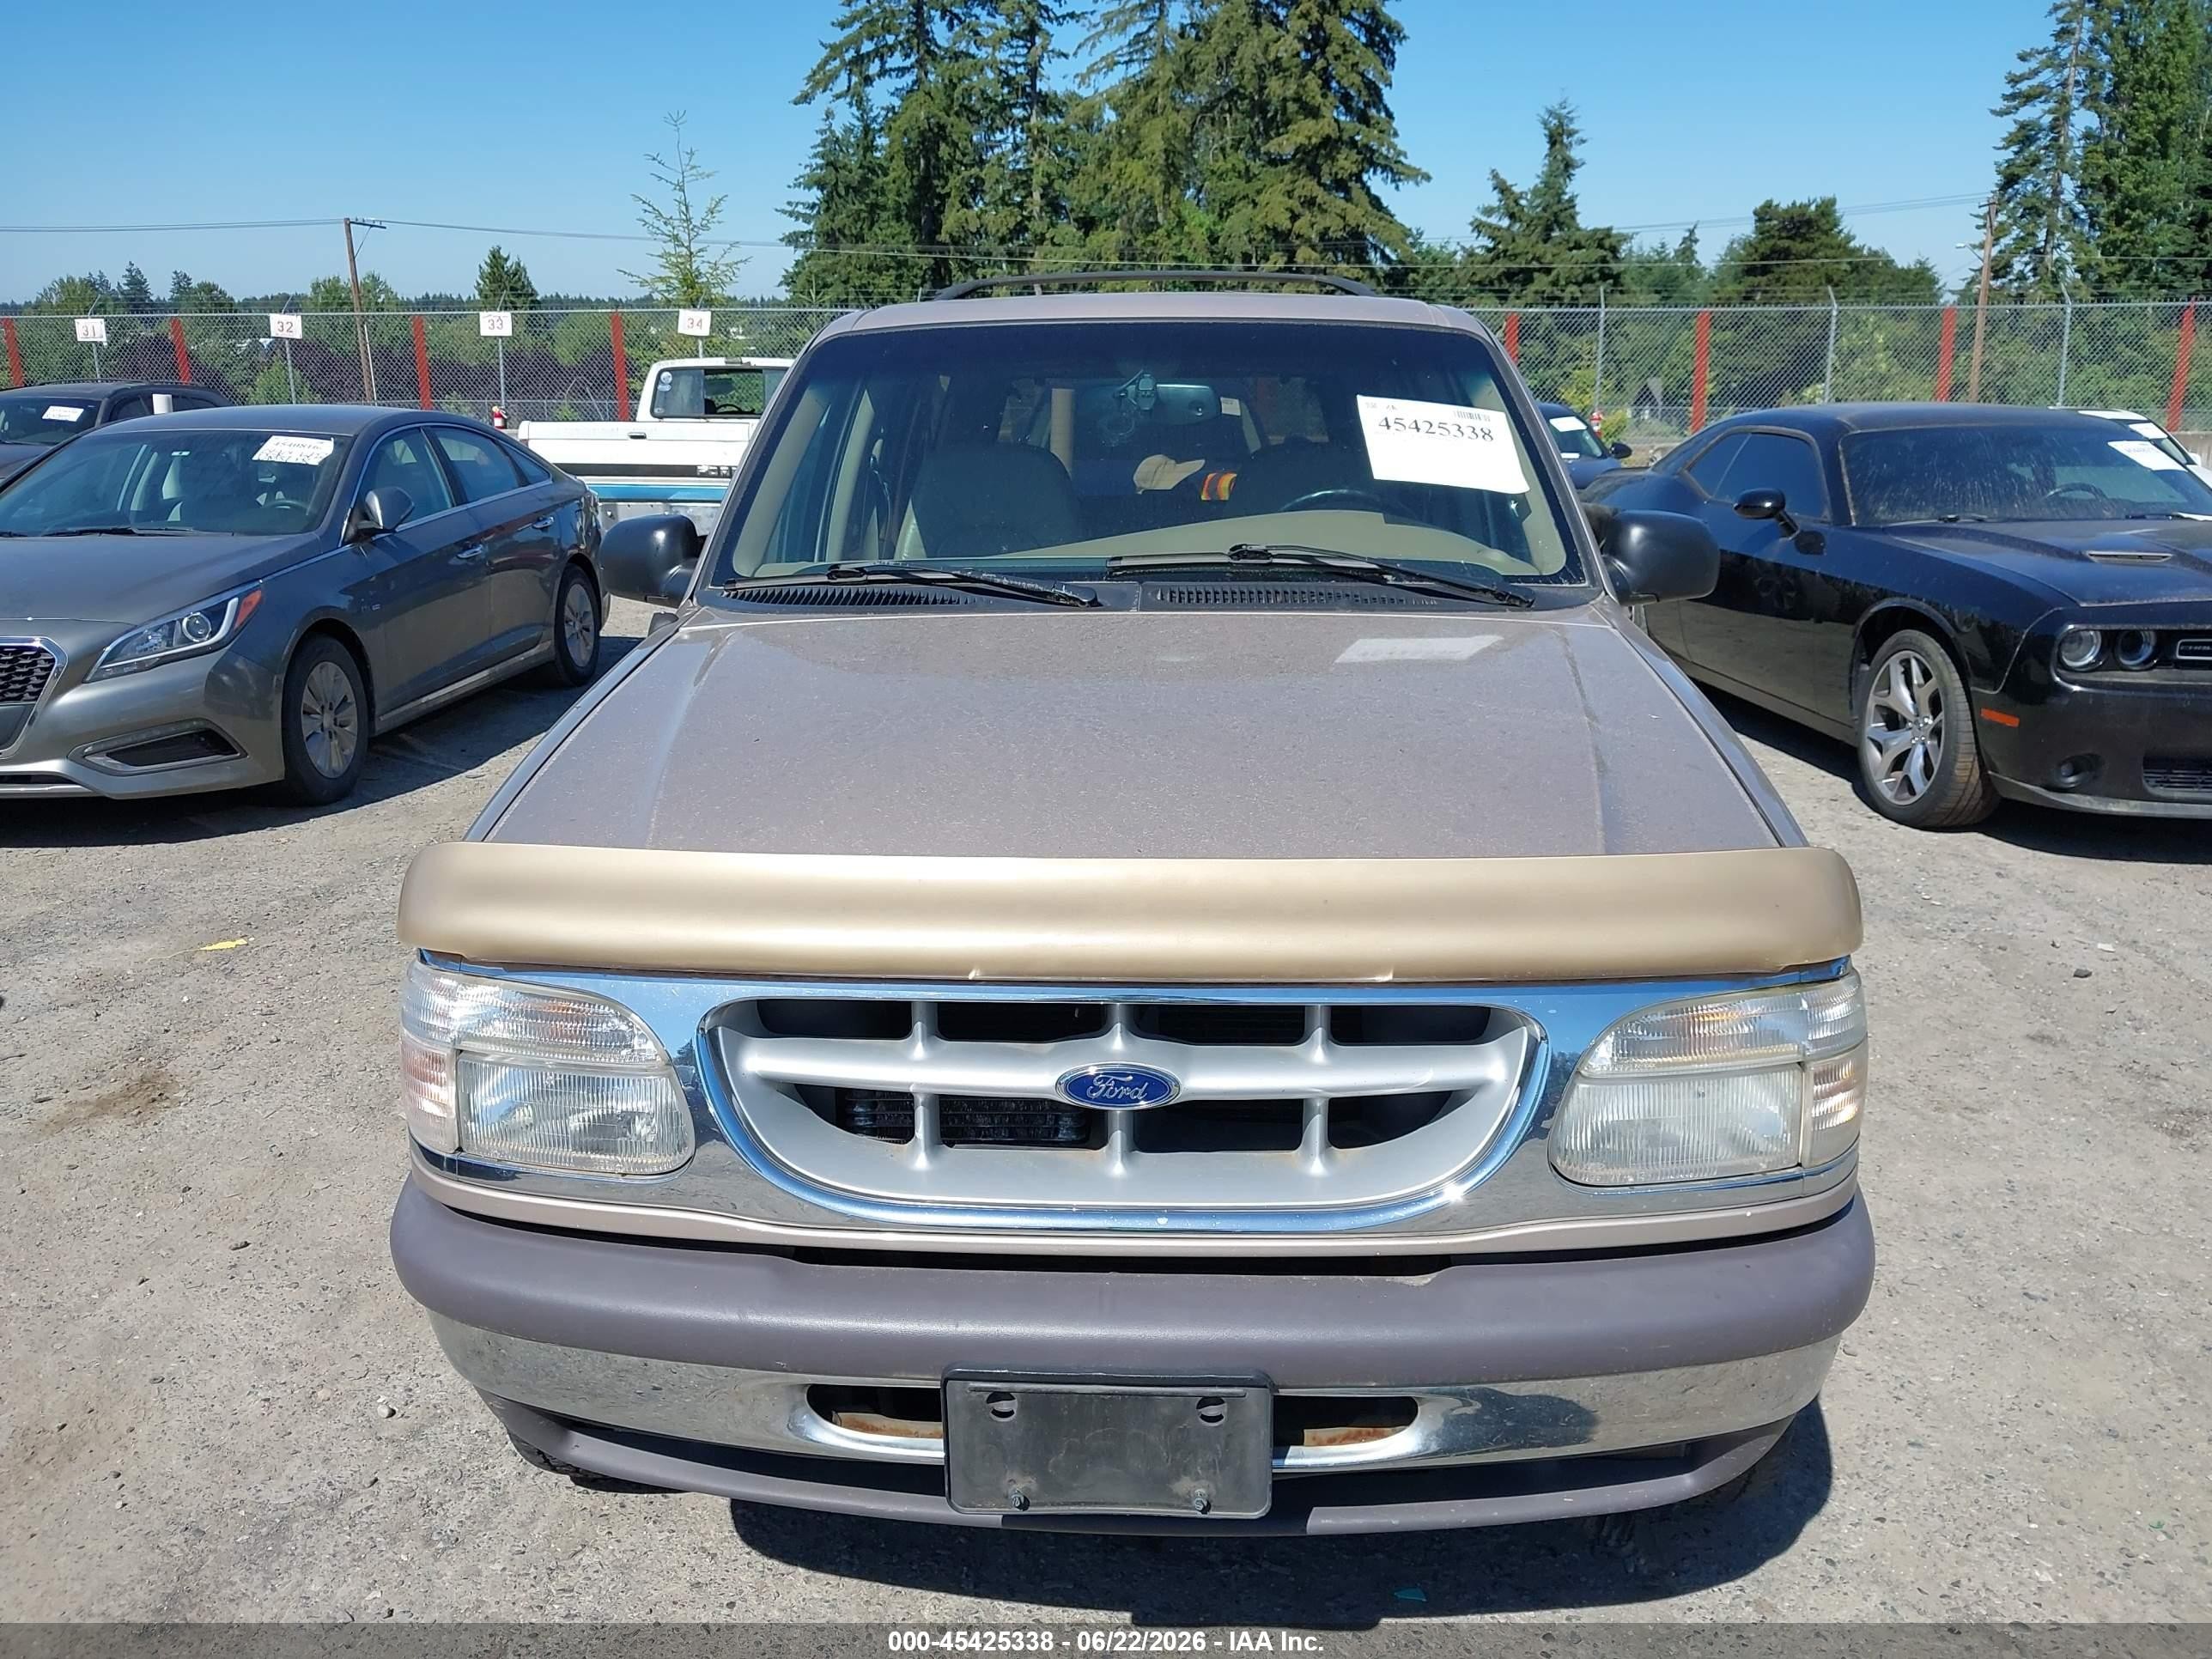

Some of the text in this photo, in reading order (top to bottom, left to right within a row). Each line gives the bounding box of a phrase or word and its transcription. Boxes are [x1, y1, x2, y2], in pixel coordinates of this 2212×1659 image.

[276, 320, 294, 334] 32
[488, 318, 503, 330] 33
[687, 317, 702, 330] 34
[82, 327, 96, 337] 31
[1378, 416, 1494, 442] 45425338
[1086, 1074, 1149, 1100] Ford
